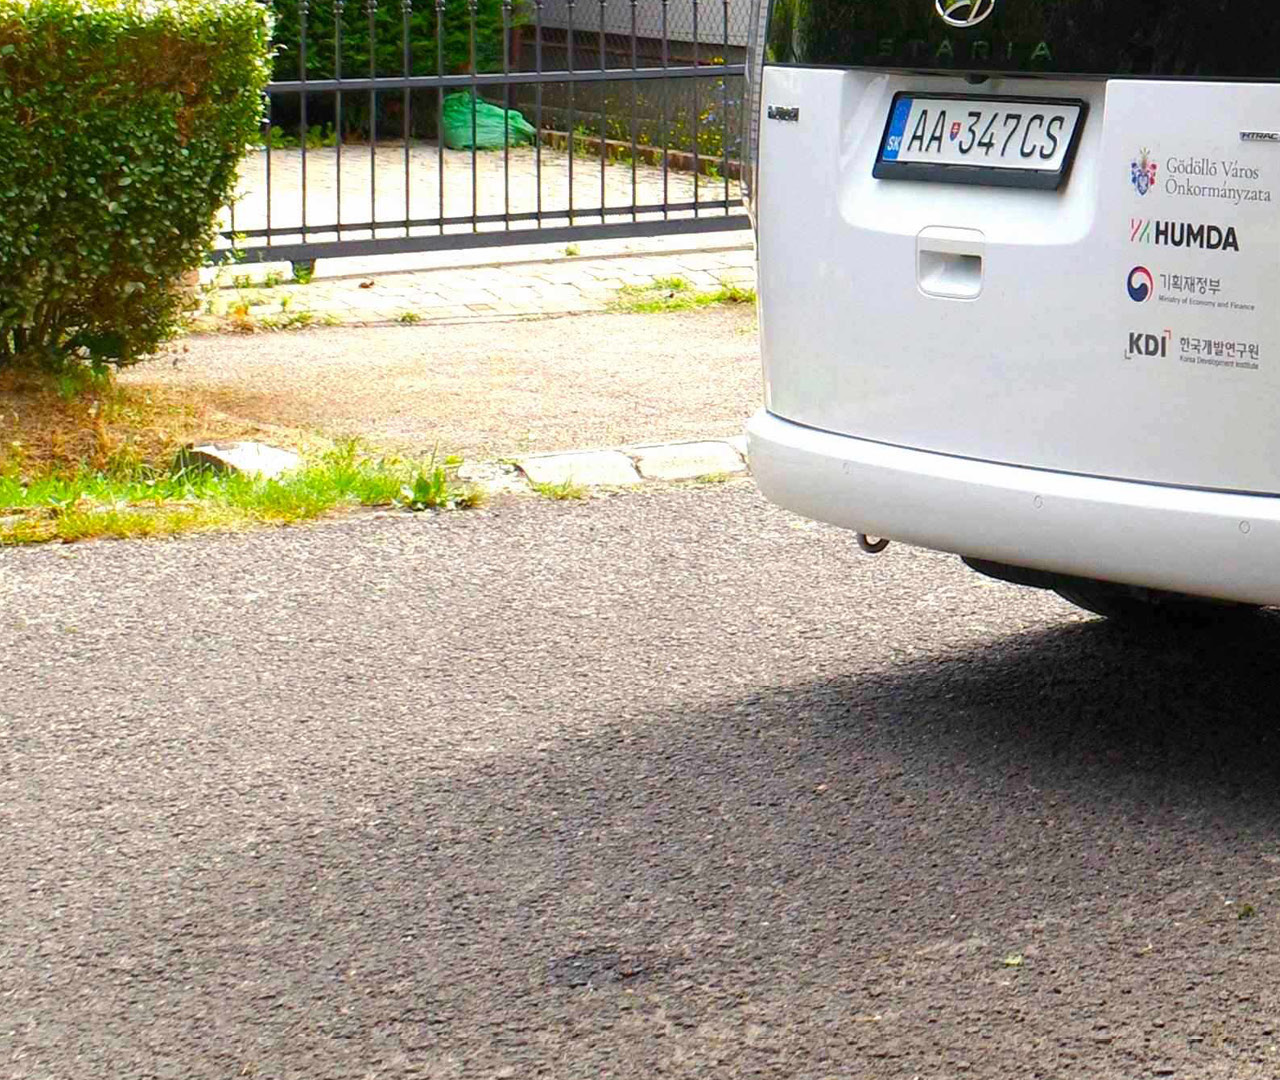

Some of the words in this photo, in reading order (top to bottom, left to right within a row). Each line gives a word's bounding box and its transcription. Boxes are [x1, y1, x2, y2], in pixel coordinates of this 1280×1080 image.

[877, 36, 1052, 61] STARIA
[886, 135, 902, 152] SK
[907, 109, 947, 153] AA
[958, 111, 1065, 160] 347CS
[1166, 157, 1218, 177] Gödöllő
[1221, 160, 1260, 180] Város
[1165, 174, 1272, 206] Önkormányzata
[1155, 220, 1240, 252] HUMDA
[1159, 273, 1222, 295] 기획재정부
[1129, 331, 1167, 358] KDI
[1179, 336, 1260, 361] 한국개발연구원
